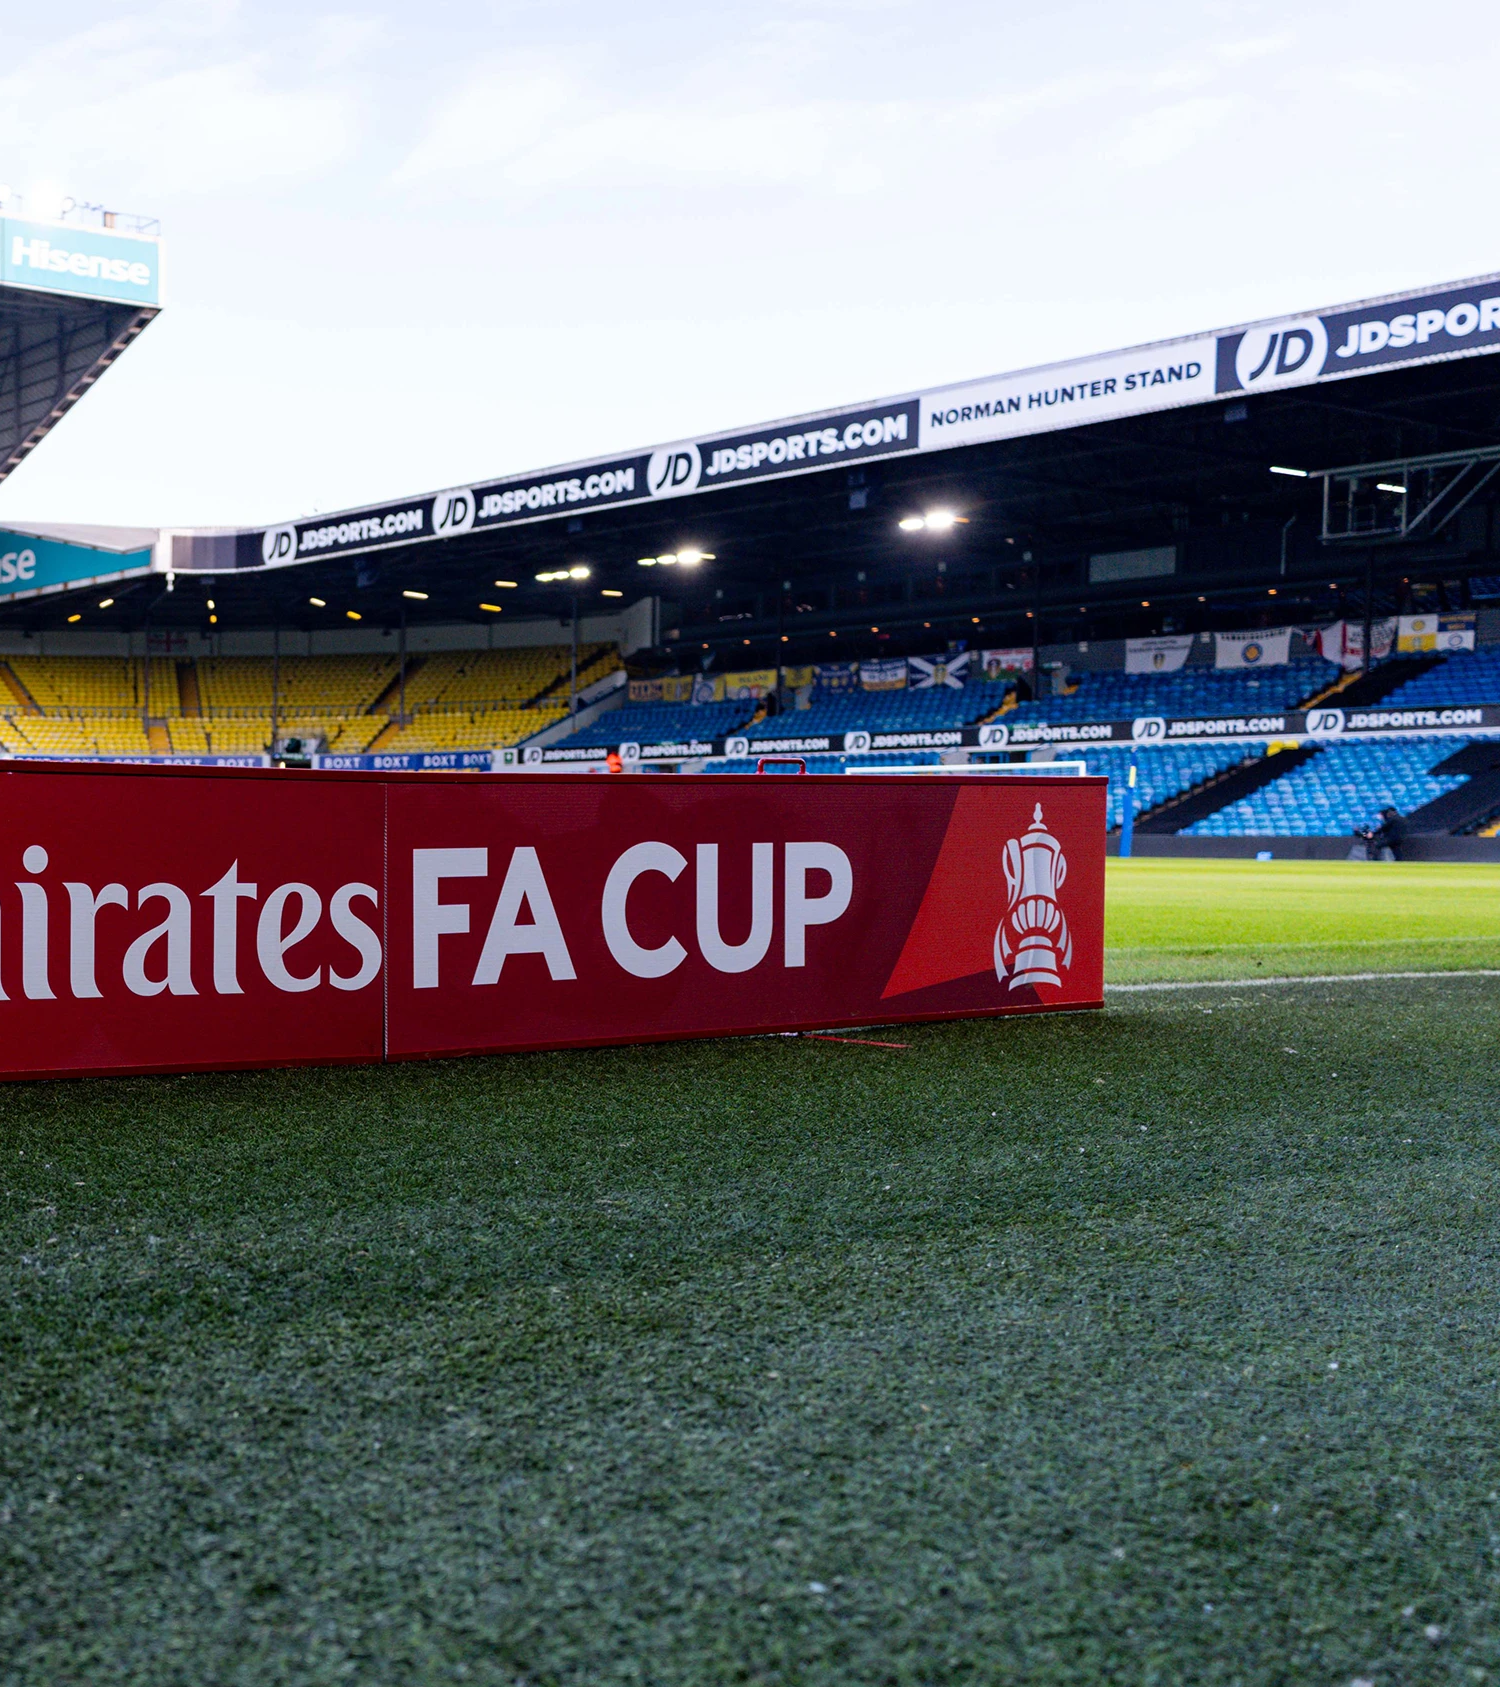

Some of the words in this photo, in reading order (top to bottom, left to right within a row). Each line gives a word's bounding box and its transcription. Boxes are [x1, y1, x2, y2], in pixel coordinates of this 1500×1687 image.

[11, 235, 150, 286] Hisense
[1249, 328, 1313, 381] JD
[931, 397, 1020, 427] NORMAN
[1028, 378, 1117, 409] HUNTER
[1125, 362, 1201, 391] STAND
[661, 452, 696, 488] JD
[706, 414, 908, 476] JDSPORTS.COM
[442, 498, 468, 527] JD
[478, 468, 634, 518] JDSPORTS.COM
[268, 532, 292, 560] JD
[298, 509, 422, 549] JDSPORTS.COM
[872, 732, 962, 748] JDSPORTS.COM
[1010, 725, 1112, 742] JDSPORTS.COM
[1168, 718, 1285, 736] JDSPORTS.COM
[1348, 709, 1482, 729] JDSPORTS.COM
[324, 757, 361, 768] BOXT
[374, 756, 410, 768] BOXT
[423, 755, 456, 768] BOXT
[750, 738, 829, 752] JDSPORTS.COM
[413, 846, 577, 989] FA
[601, 841, 854, 979] CUP
